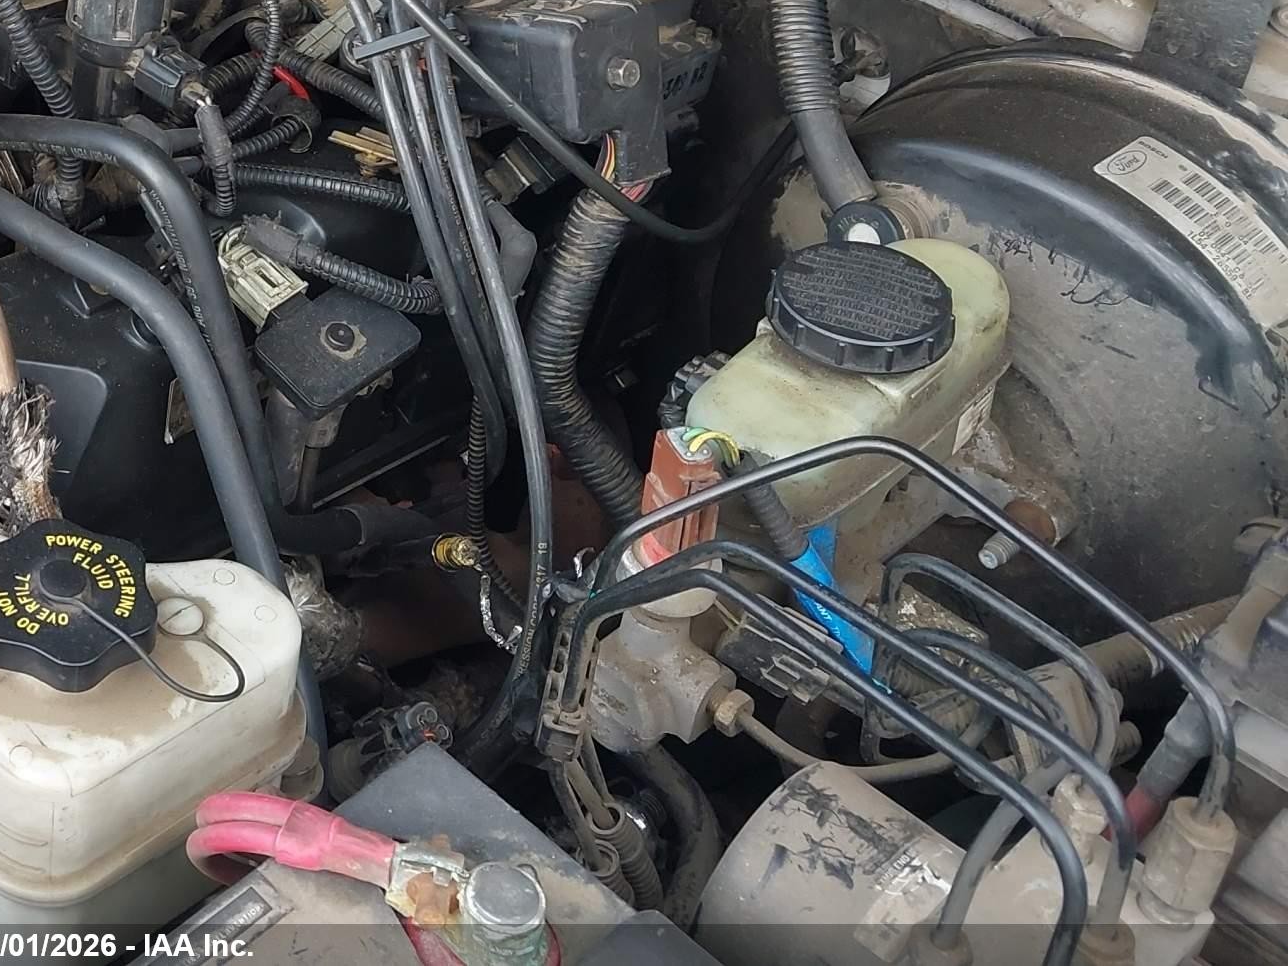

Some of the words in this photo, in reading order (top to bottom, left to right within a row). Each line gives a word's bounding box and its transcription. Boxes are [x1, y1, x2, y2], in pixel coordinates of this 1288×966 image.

[45, 534, 103, 555] POWER
[105, 554, 136, 618] STEERING
[72, 552, 114, 589] FLUID
[14, 573, 69, 626] OVERFILL
[16, 617, 40, 635] DO
[892, 853, 910, 870] END
